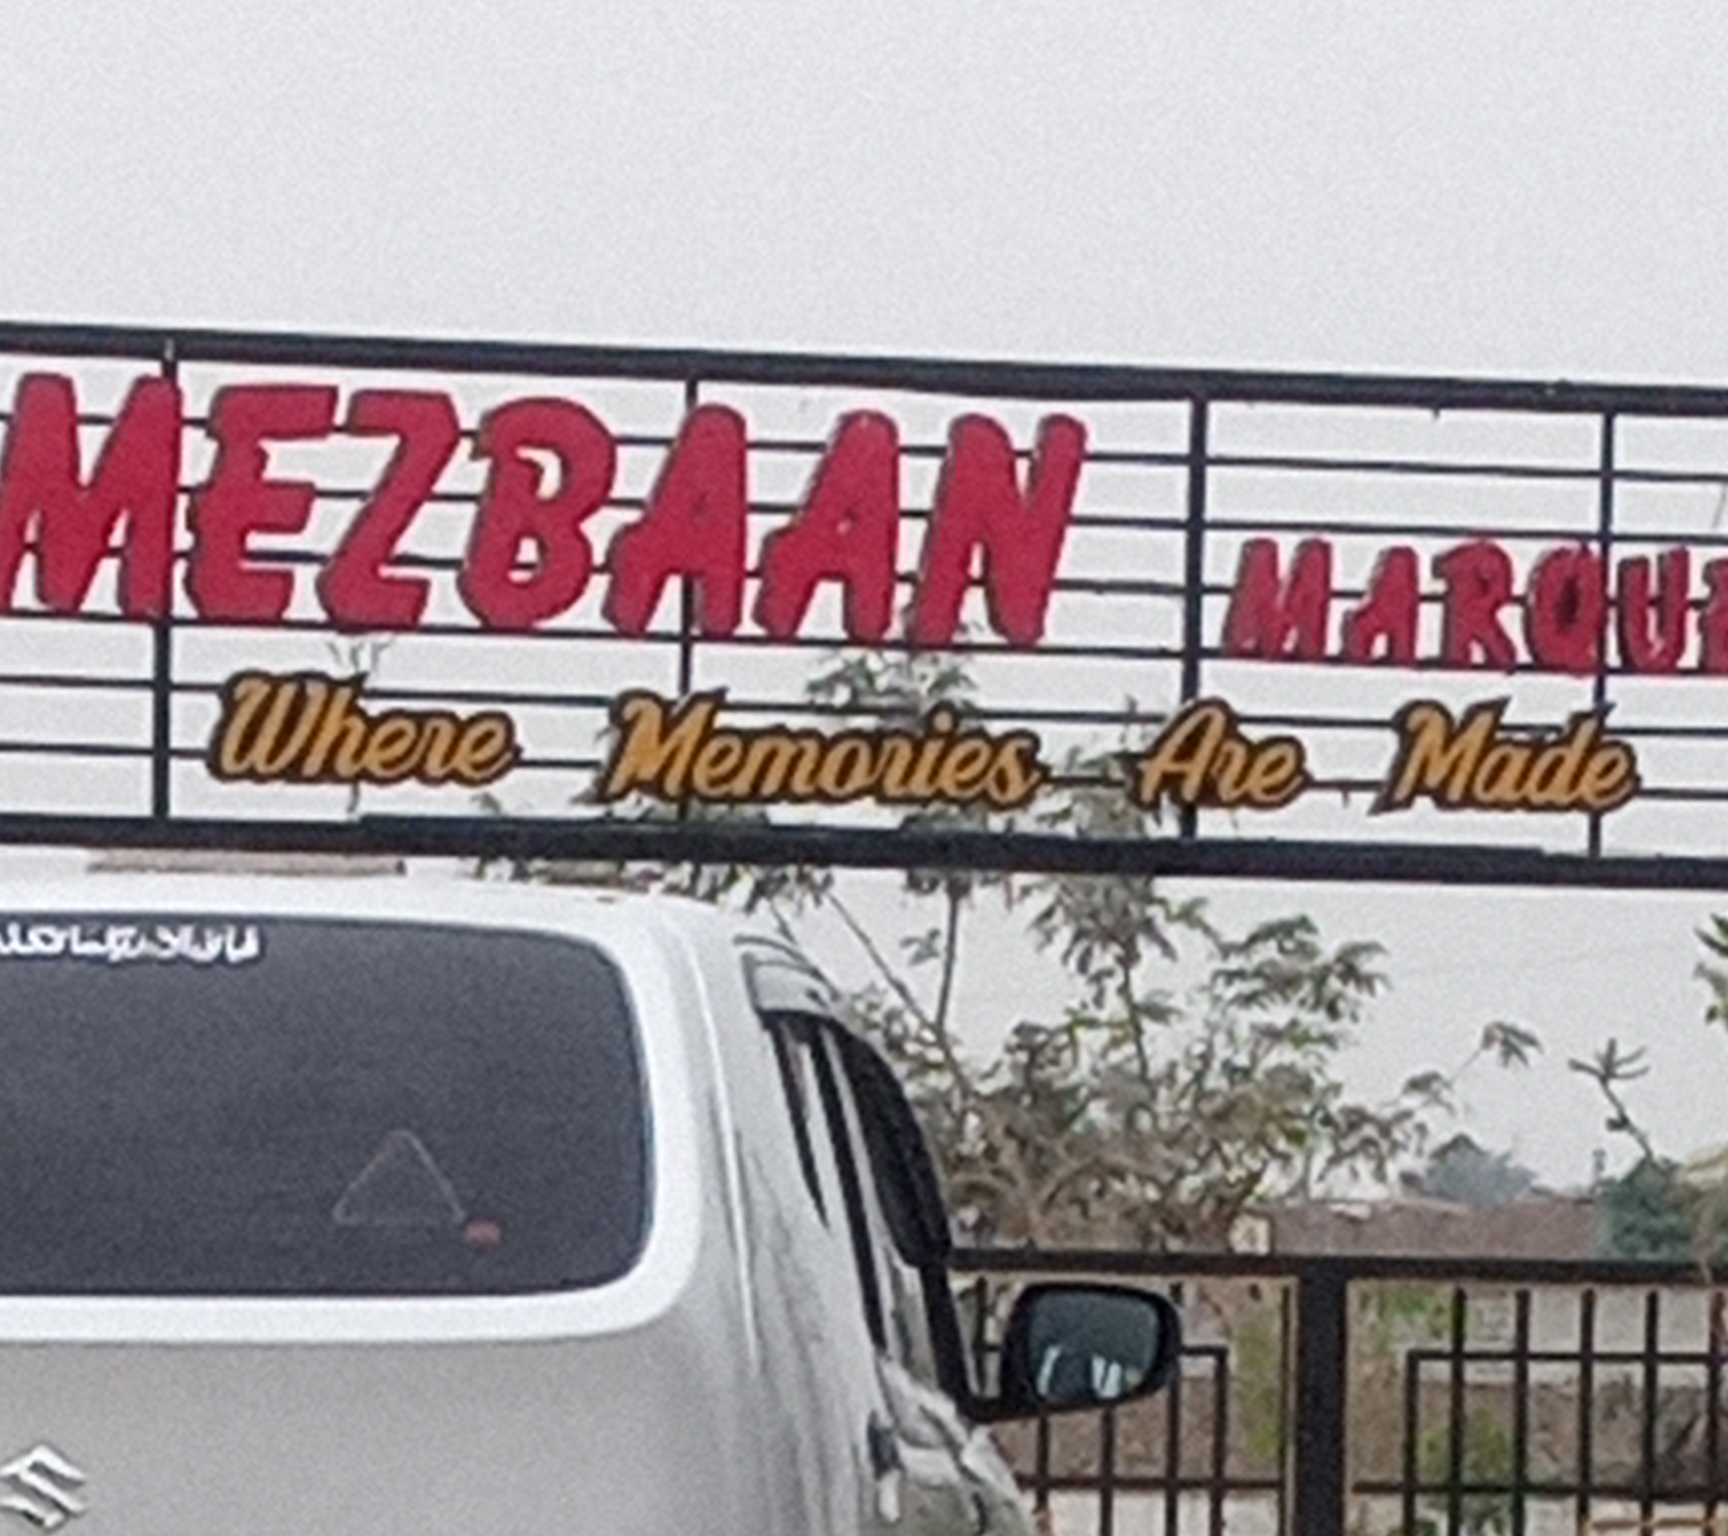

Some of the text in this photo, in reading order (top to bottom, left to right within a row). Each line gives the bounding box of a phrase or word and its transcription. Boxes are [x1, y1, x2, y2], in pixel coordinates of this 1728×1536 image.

[208, 671, 1639, 814] Where Memories Are Made
